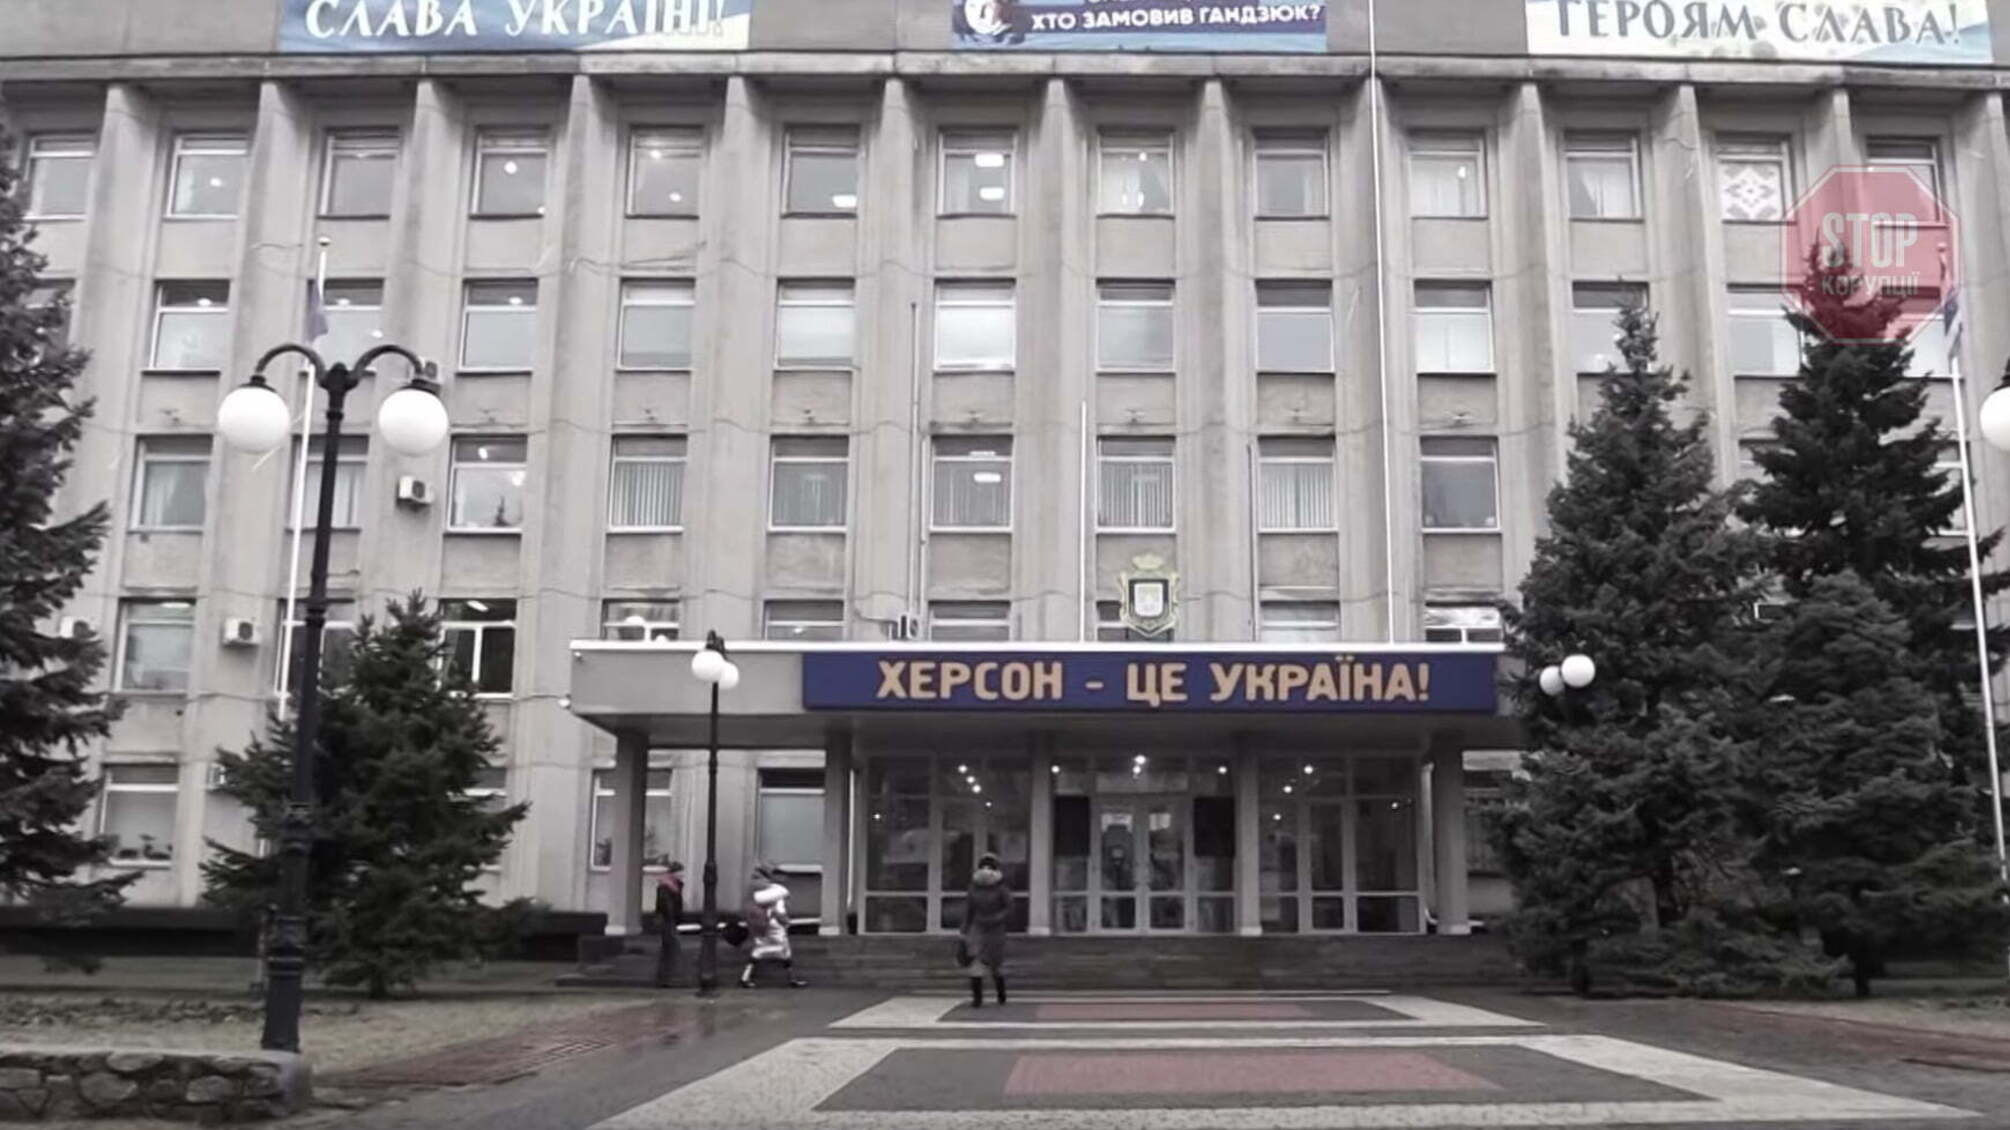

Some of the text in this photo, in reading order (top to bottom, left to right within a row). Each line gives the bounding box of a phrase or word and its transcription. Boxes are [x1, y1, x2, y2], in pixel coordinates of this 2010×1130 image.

[305, 0, 479, 37] СЛАВА
[1031, 5, 1321, 30] ХТО ЗАМОВИВ ГАНДЗЮК?
[1557, 0, 1960, 43] ГЕРОЯМ СЛАВА!
[876, 661, 1063, 700] ХЕРСОН
[1126, 662, 1187, 708] ЦЕ
[1210, 655, 1430, 702] УКРАЇНА!
